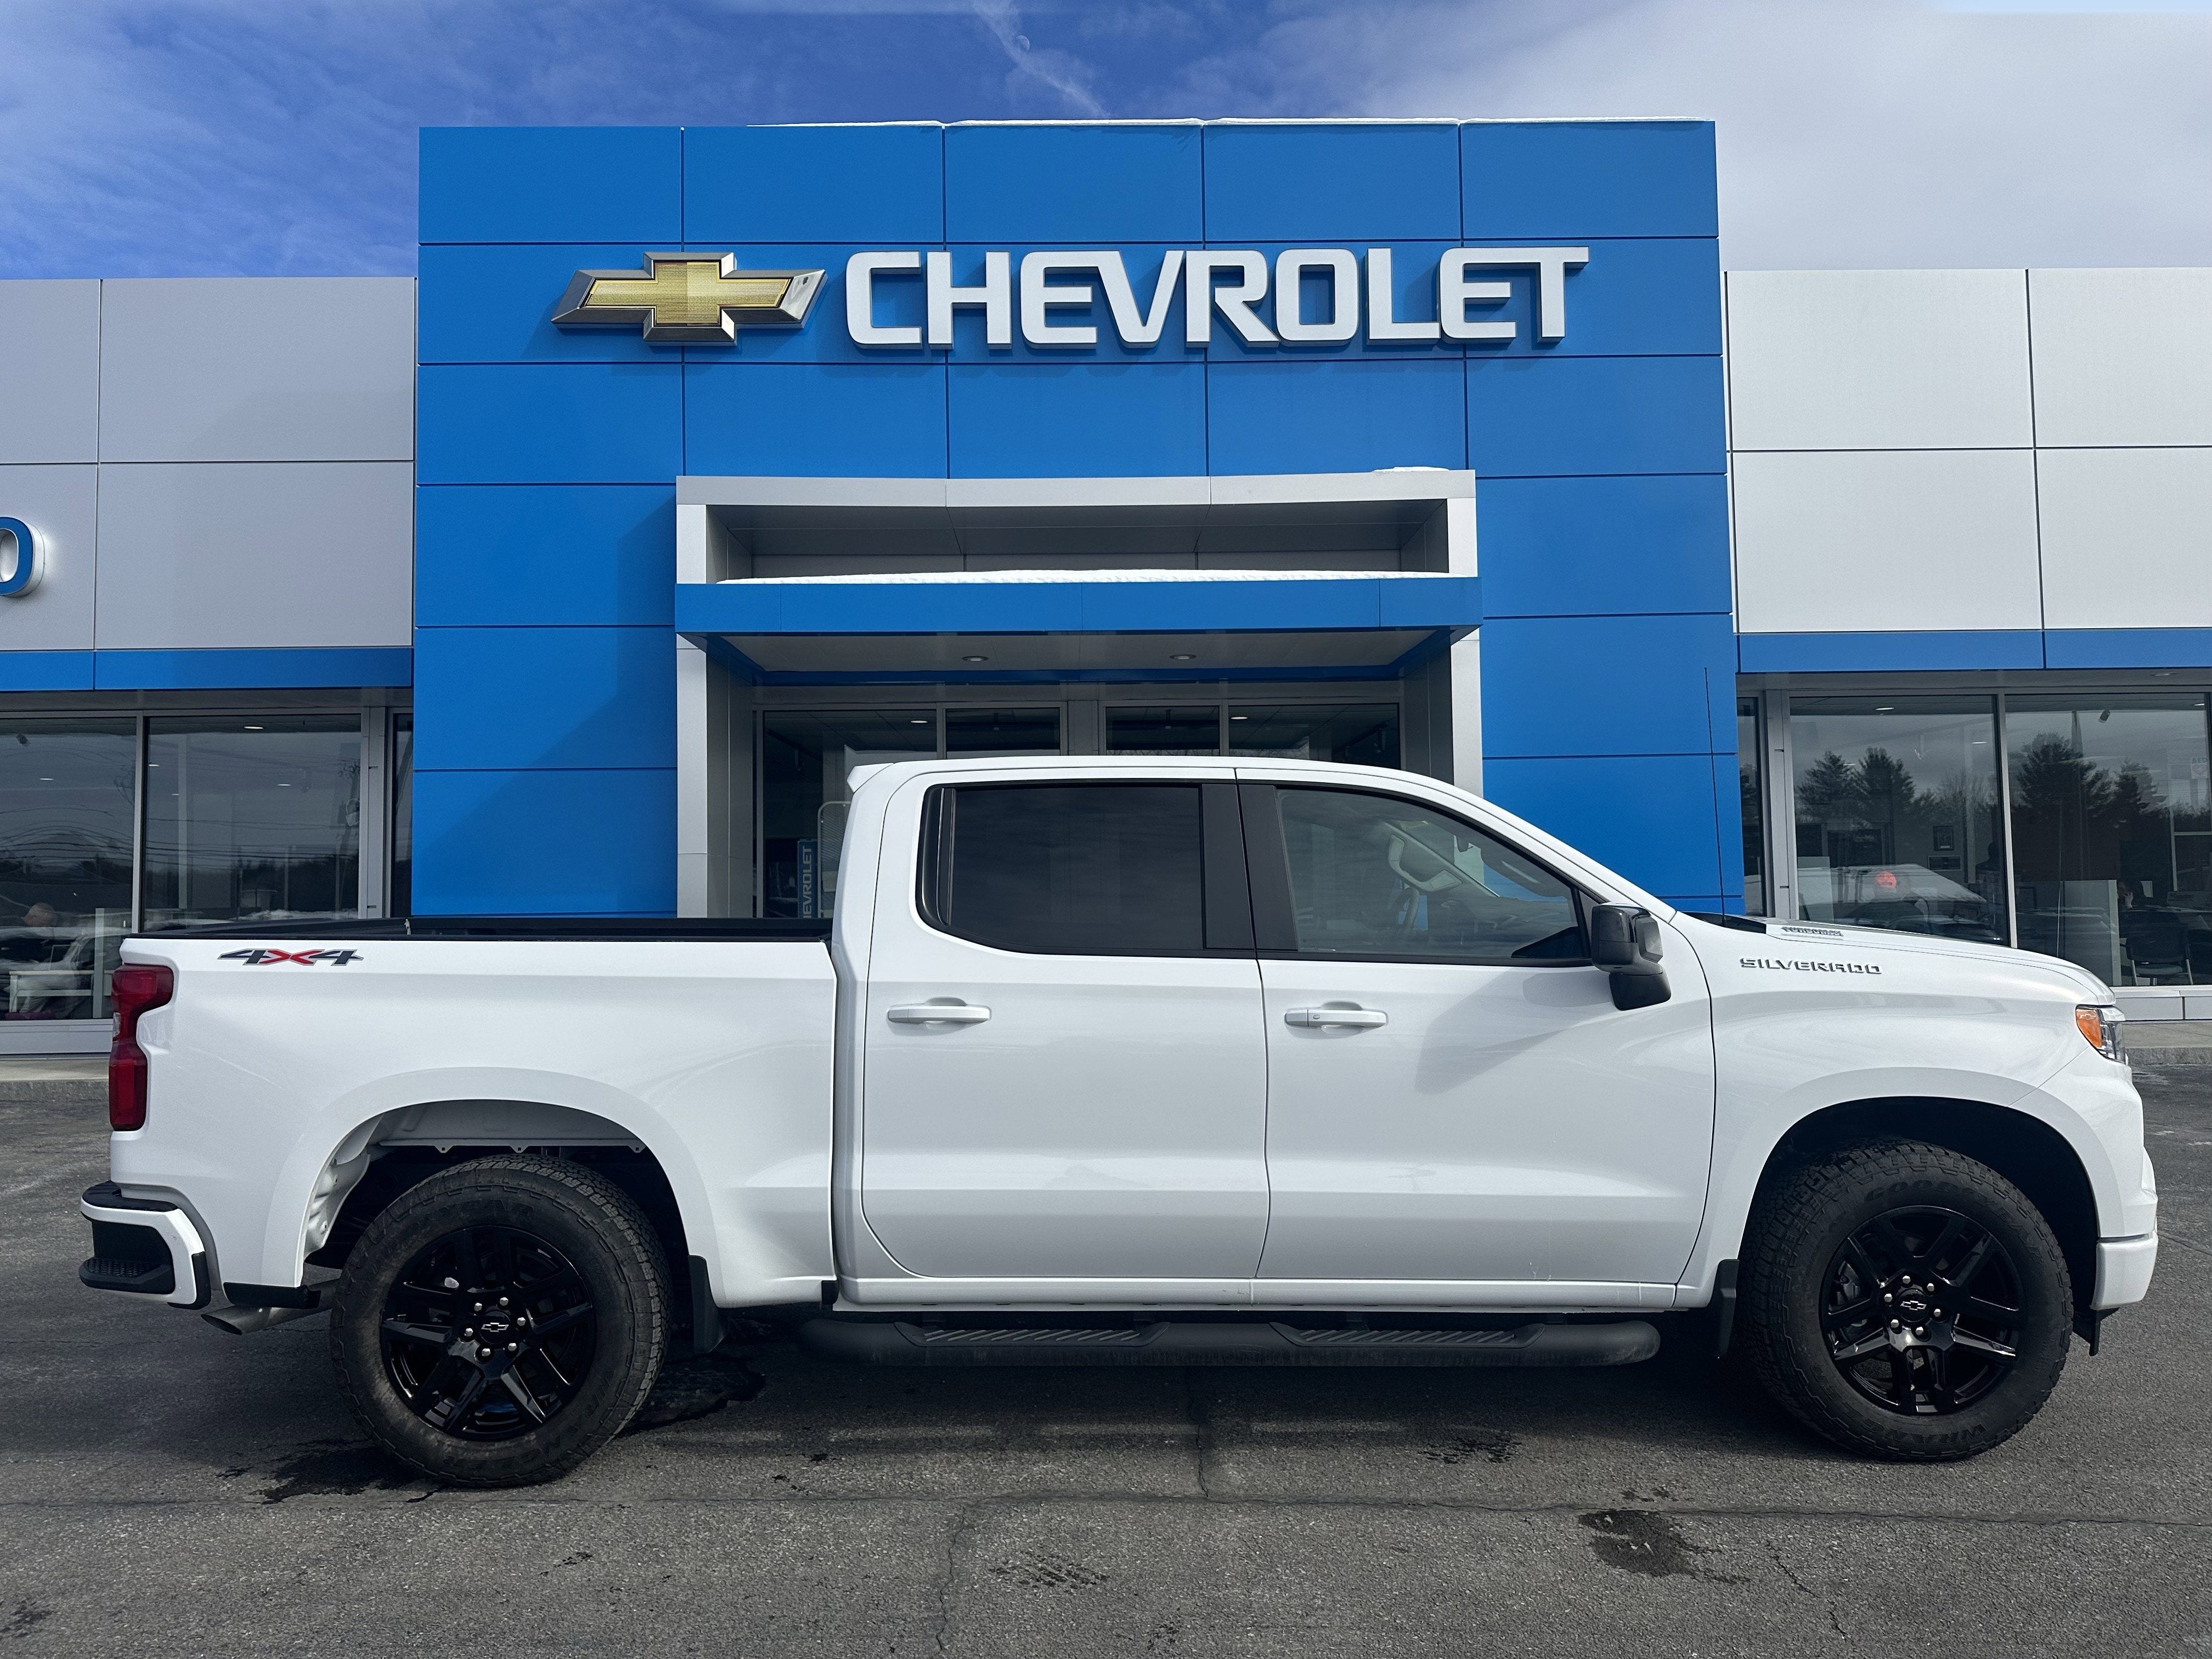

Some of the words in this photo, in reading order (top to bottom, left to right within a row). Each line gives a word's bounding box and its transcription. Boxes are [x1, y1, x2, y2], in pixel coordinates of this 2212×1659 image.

[846, 246, 1589, 349] CHEVROLET
[217, 949, 364, 966] 4X4
[1740, 958, 1882, 974] SILVERADO
[1863, 1179, 2044, 1265] GOODYEAR
[1808, 1364, 1988, 1447] WRANGLER
